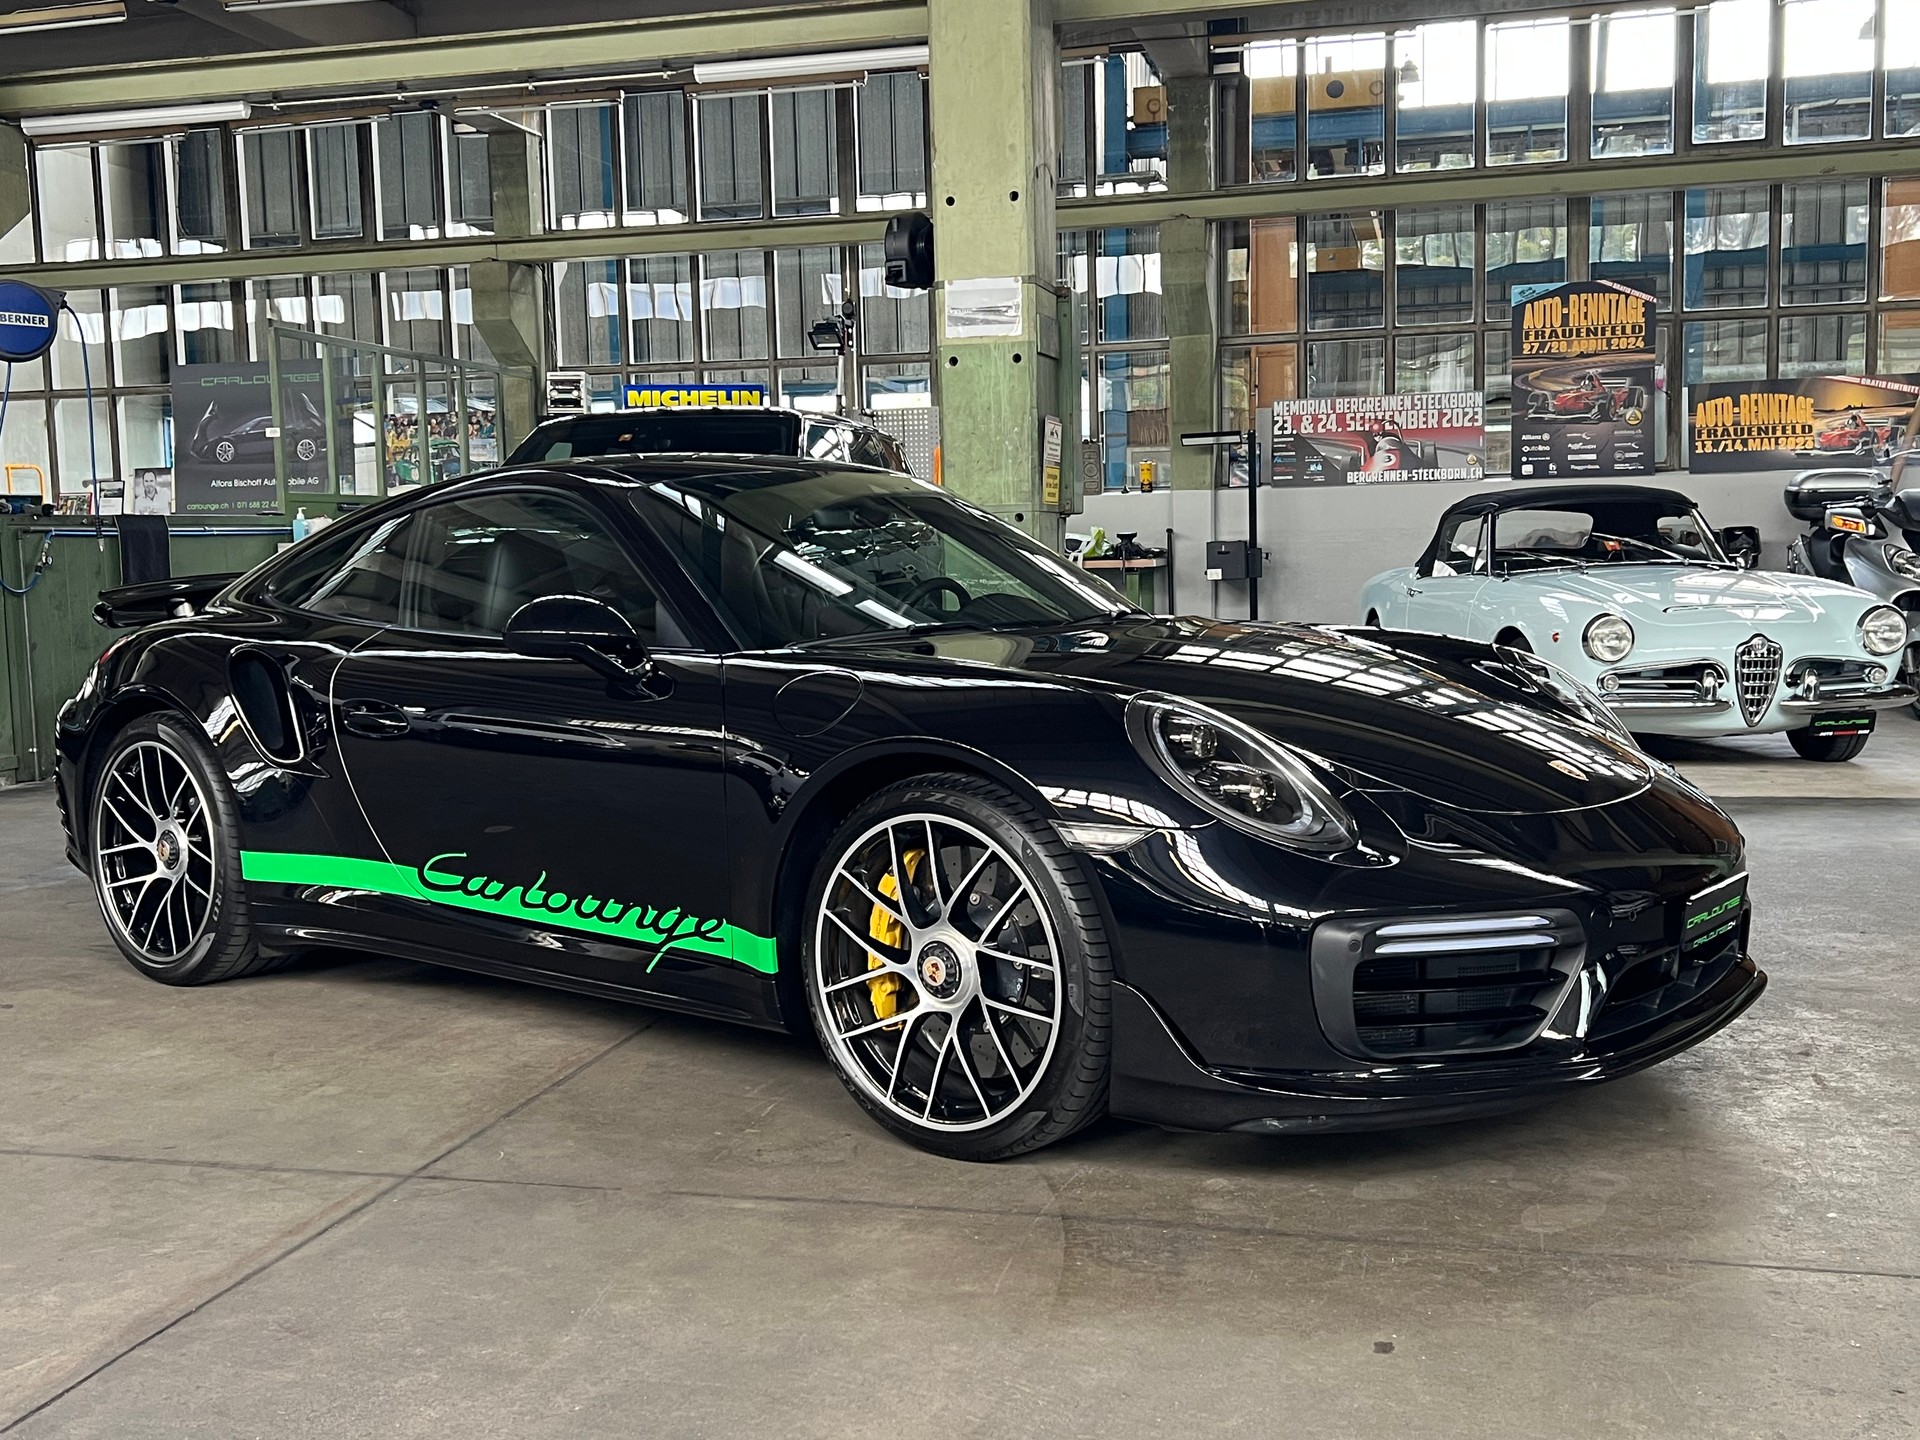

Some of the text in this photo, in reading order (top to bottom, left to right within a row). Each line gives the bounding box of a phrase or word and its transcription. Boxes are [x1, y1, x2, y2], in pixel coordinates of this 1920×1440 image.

[1523, 292, 1645, 329] AUTO-RENNTAGE
[0, 313, 46, 326] BERNER
[1524, 324, 1644, 341] FRAUENFELD
[1610, 336, 1645, 350] 2024
[1861, 378, 1919, 394] GRATIS EINTRITT
[627, 390, 760, 406] MICHELIN
[1273, 391, 1483, 416] MEMORIAL BERGRENNEN STECKBORN
[1695, 393, 1815, 427] AUTO-RENNTAGE
[1273, 416, 1298, 435] 23.
[1300, 415, 1315, 434] &
[1317, 413, 1342, 433] 24.
[1442, 407, 1483, 428] 2023
[1696, 424, 1814, 439] FRAUENFELD
[210, 479, 233, 487] Alfons
[233, 479, 262, 487] Bischoff
[306, 476, 320, 485] AG
[1346, 467, 1483, 484] BERGRENNEN-STECKBORN.CH
[186, 502, 230, 511] carlounge.ch
[261, 501, 270, 509] 22
[417, 852, 727, 974] Carlounge
[1686, 895, 1741, 929] CARLOUNGE
